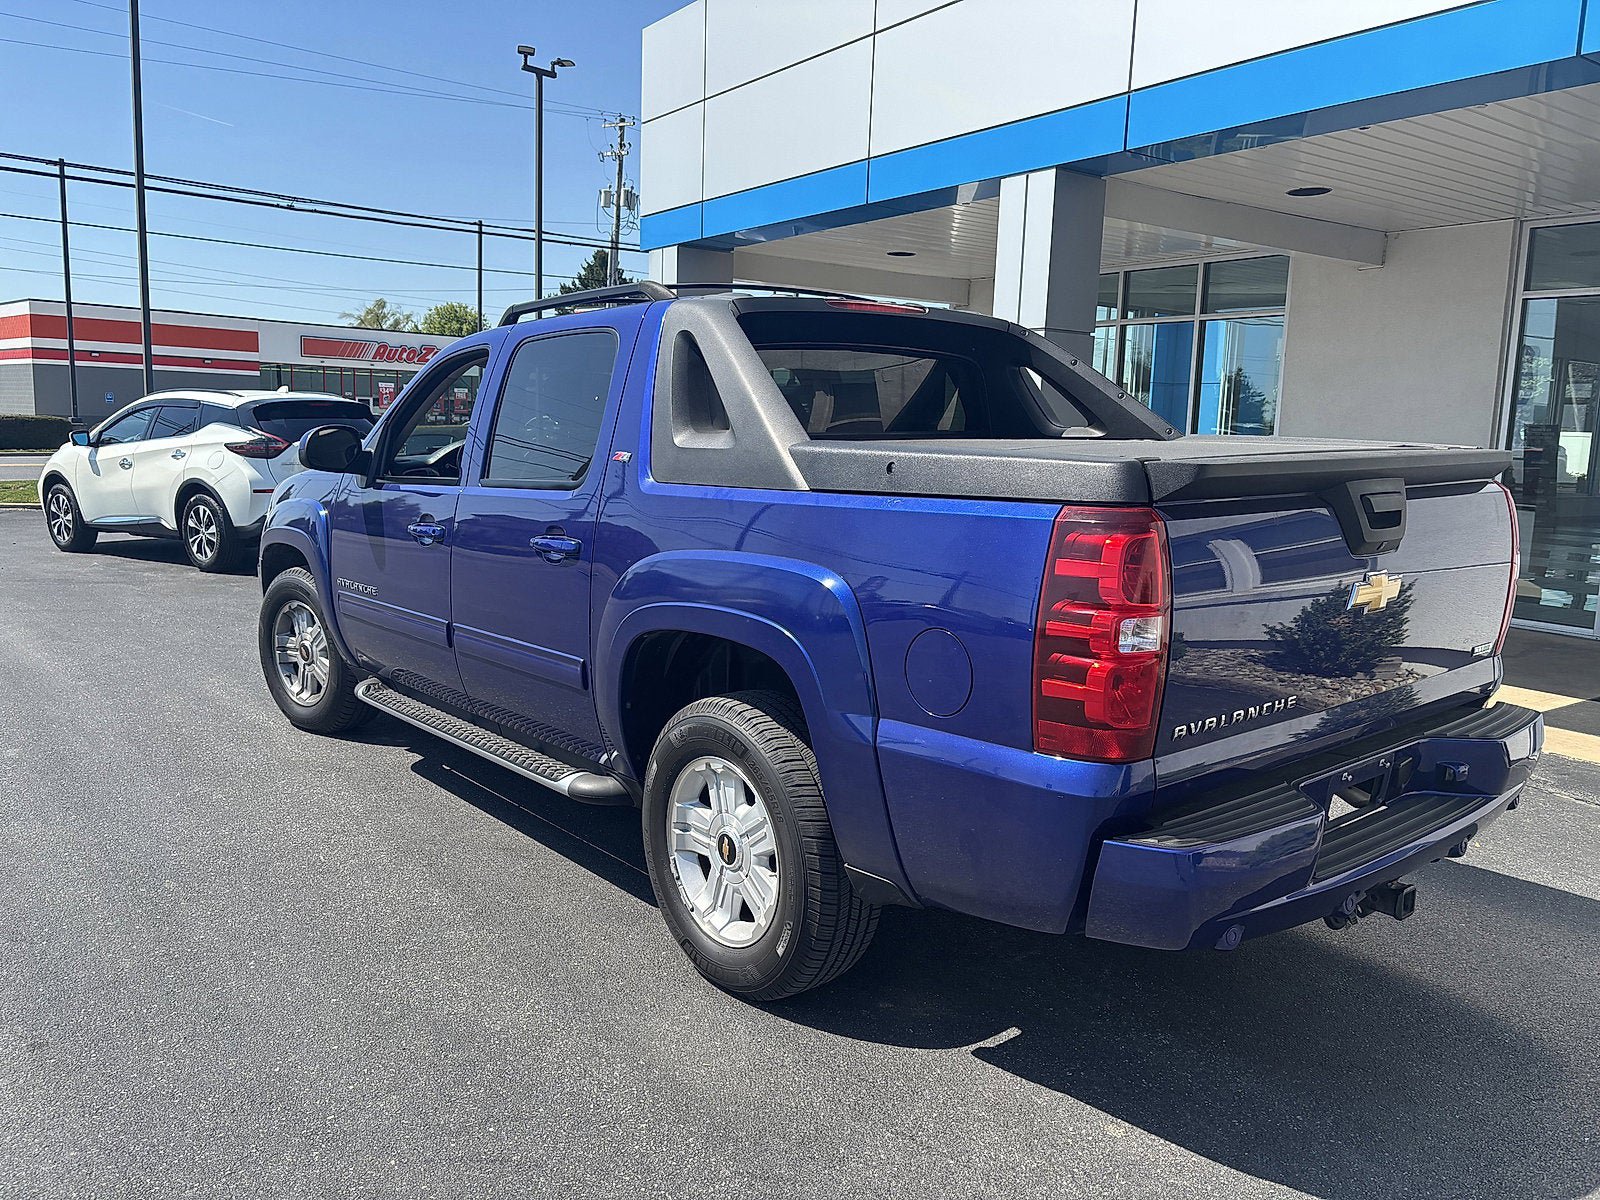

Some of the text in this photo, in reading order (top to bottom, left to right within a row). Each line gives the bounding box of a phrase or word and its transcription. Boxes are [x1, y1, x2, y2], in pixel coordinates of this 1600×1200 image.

[371, 343, 440, 363] AutoZ
[337, 577, 378, 596] AVALANCHE
[1172, 695, 1297, 741] AVALANCHE
